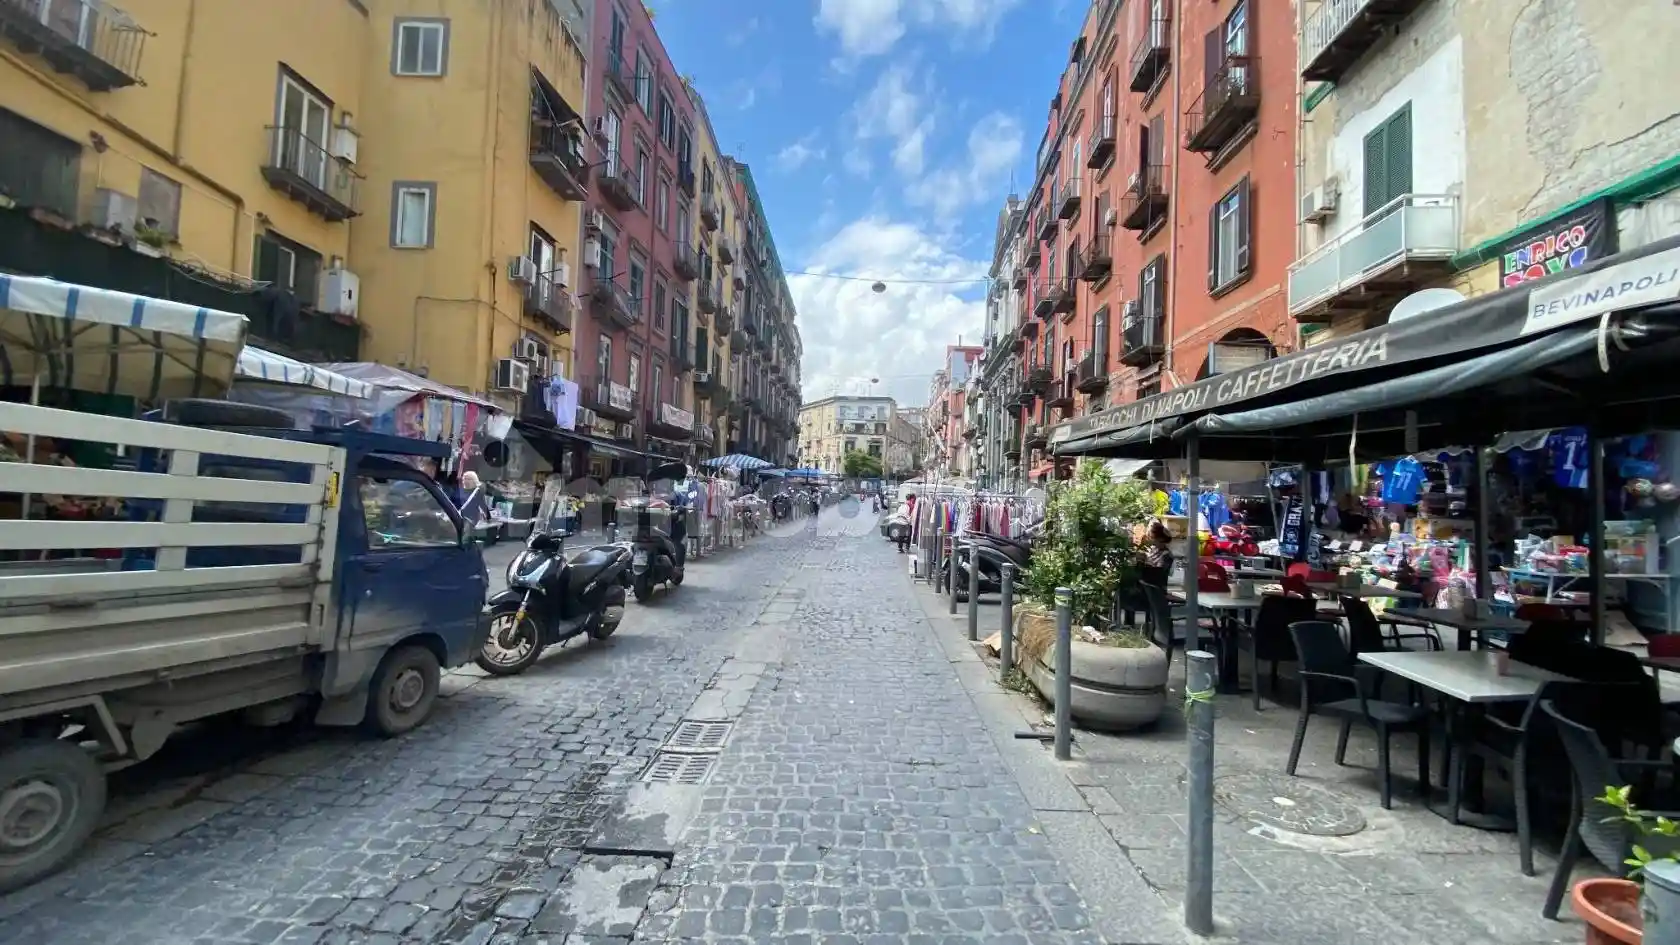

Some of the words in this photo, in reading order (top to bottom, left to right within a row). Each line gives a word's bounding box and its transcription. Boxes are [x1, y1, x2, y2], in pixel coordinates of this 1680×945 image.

[1503, 225, 1586, 274] ENRICO
[1533, 268, 1679, 320] BEVINAPOLI
[1141, 401, 1156, 421] DI
[1155, 384, 1211, 418] NAPOLI
[1217, 332, 1390, 402] CAFFETTERIA
